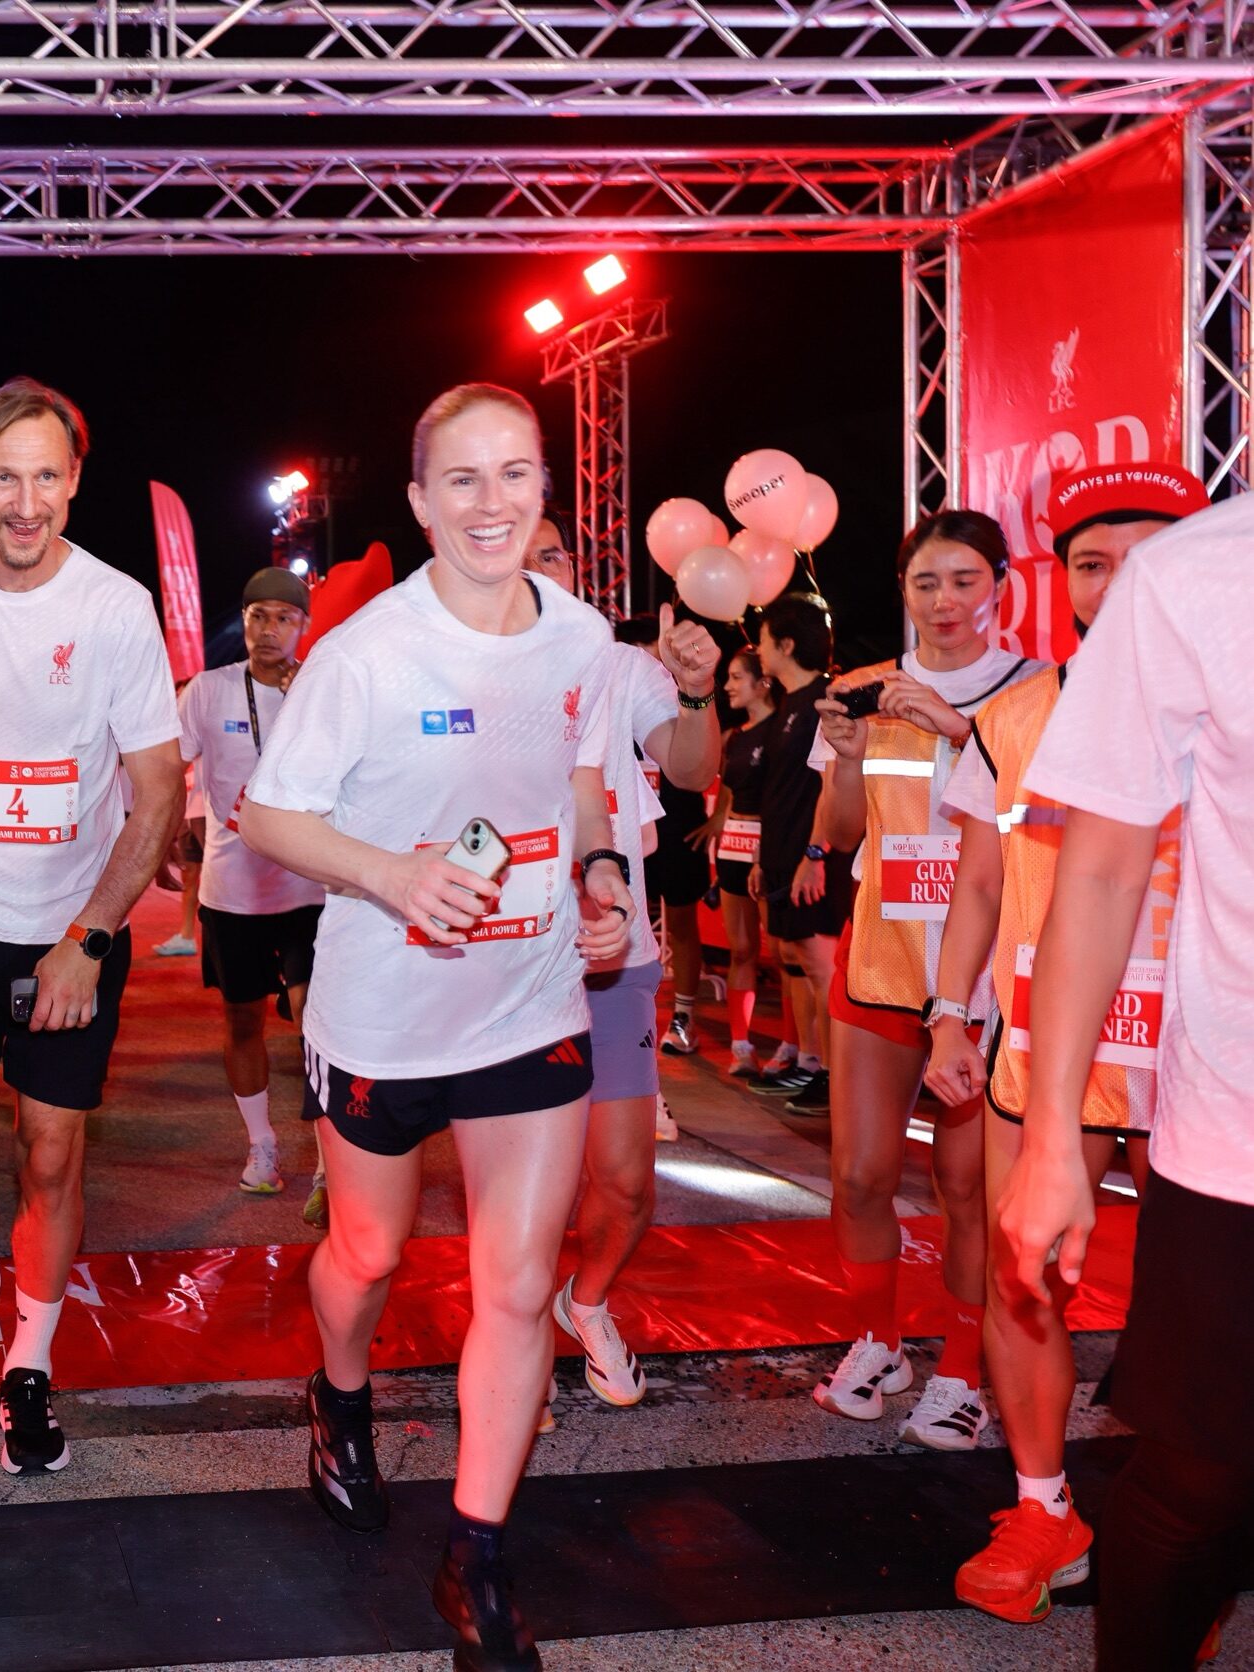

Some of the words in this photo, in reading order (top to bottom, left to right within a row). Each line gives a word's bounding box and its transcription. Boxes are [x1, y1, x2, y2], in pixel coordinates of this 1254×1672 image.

[1058, 476, 1103, 506] ALWAYS
[1106, 472, 1123, 485] BE
[451, 721, 472, 732] AXA
[6, 788, 29, 823] 4
[14, 830, 41, 840] HYYPIA
[942, 840, 950, 850] 5
[916, 861, 958, 882] GUA
[910, 882, 954, 903] RUN
[491, 923, 520, 936] DOWIE
